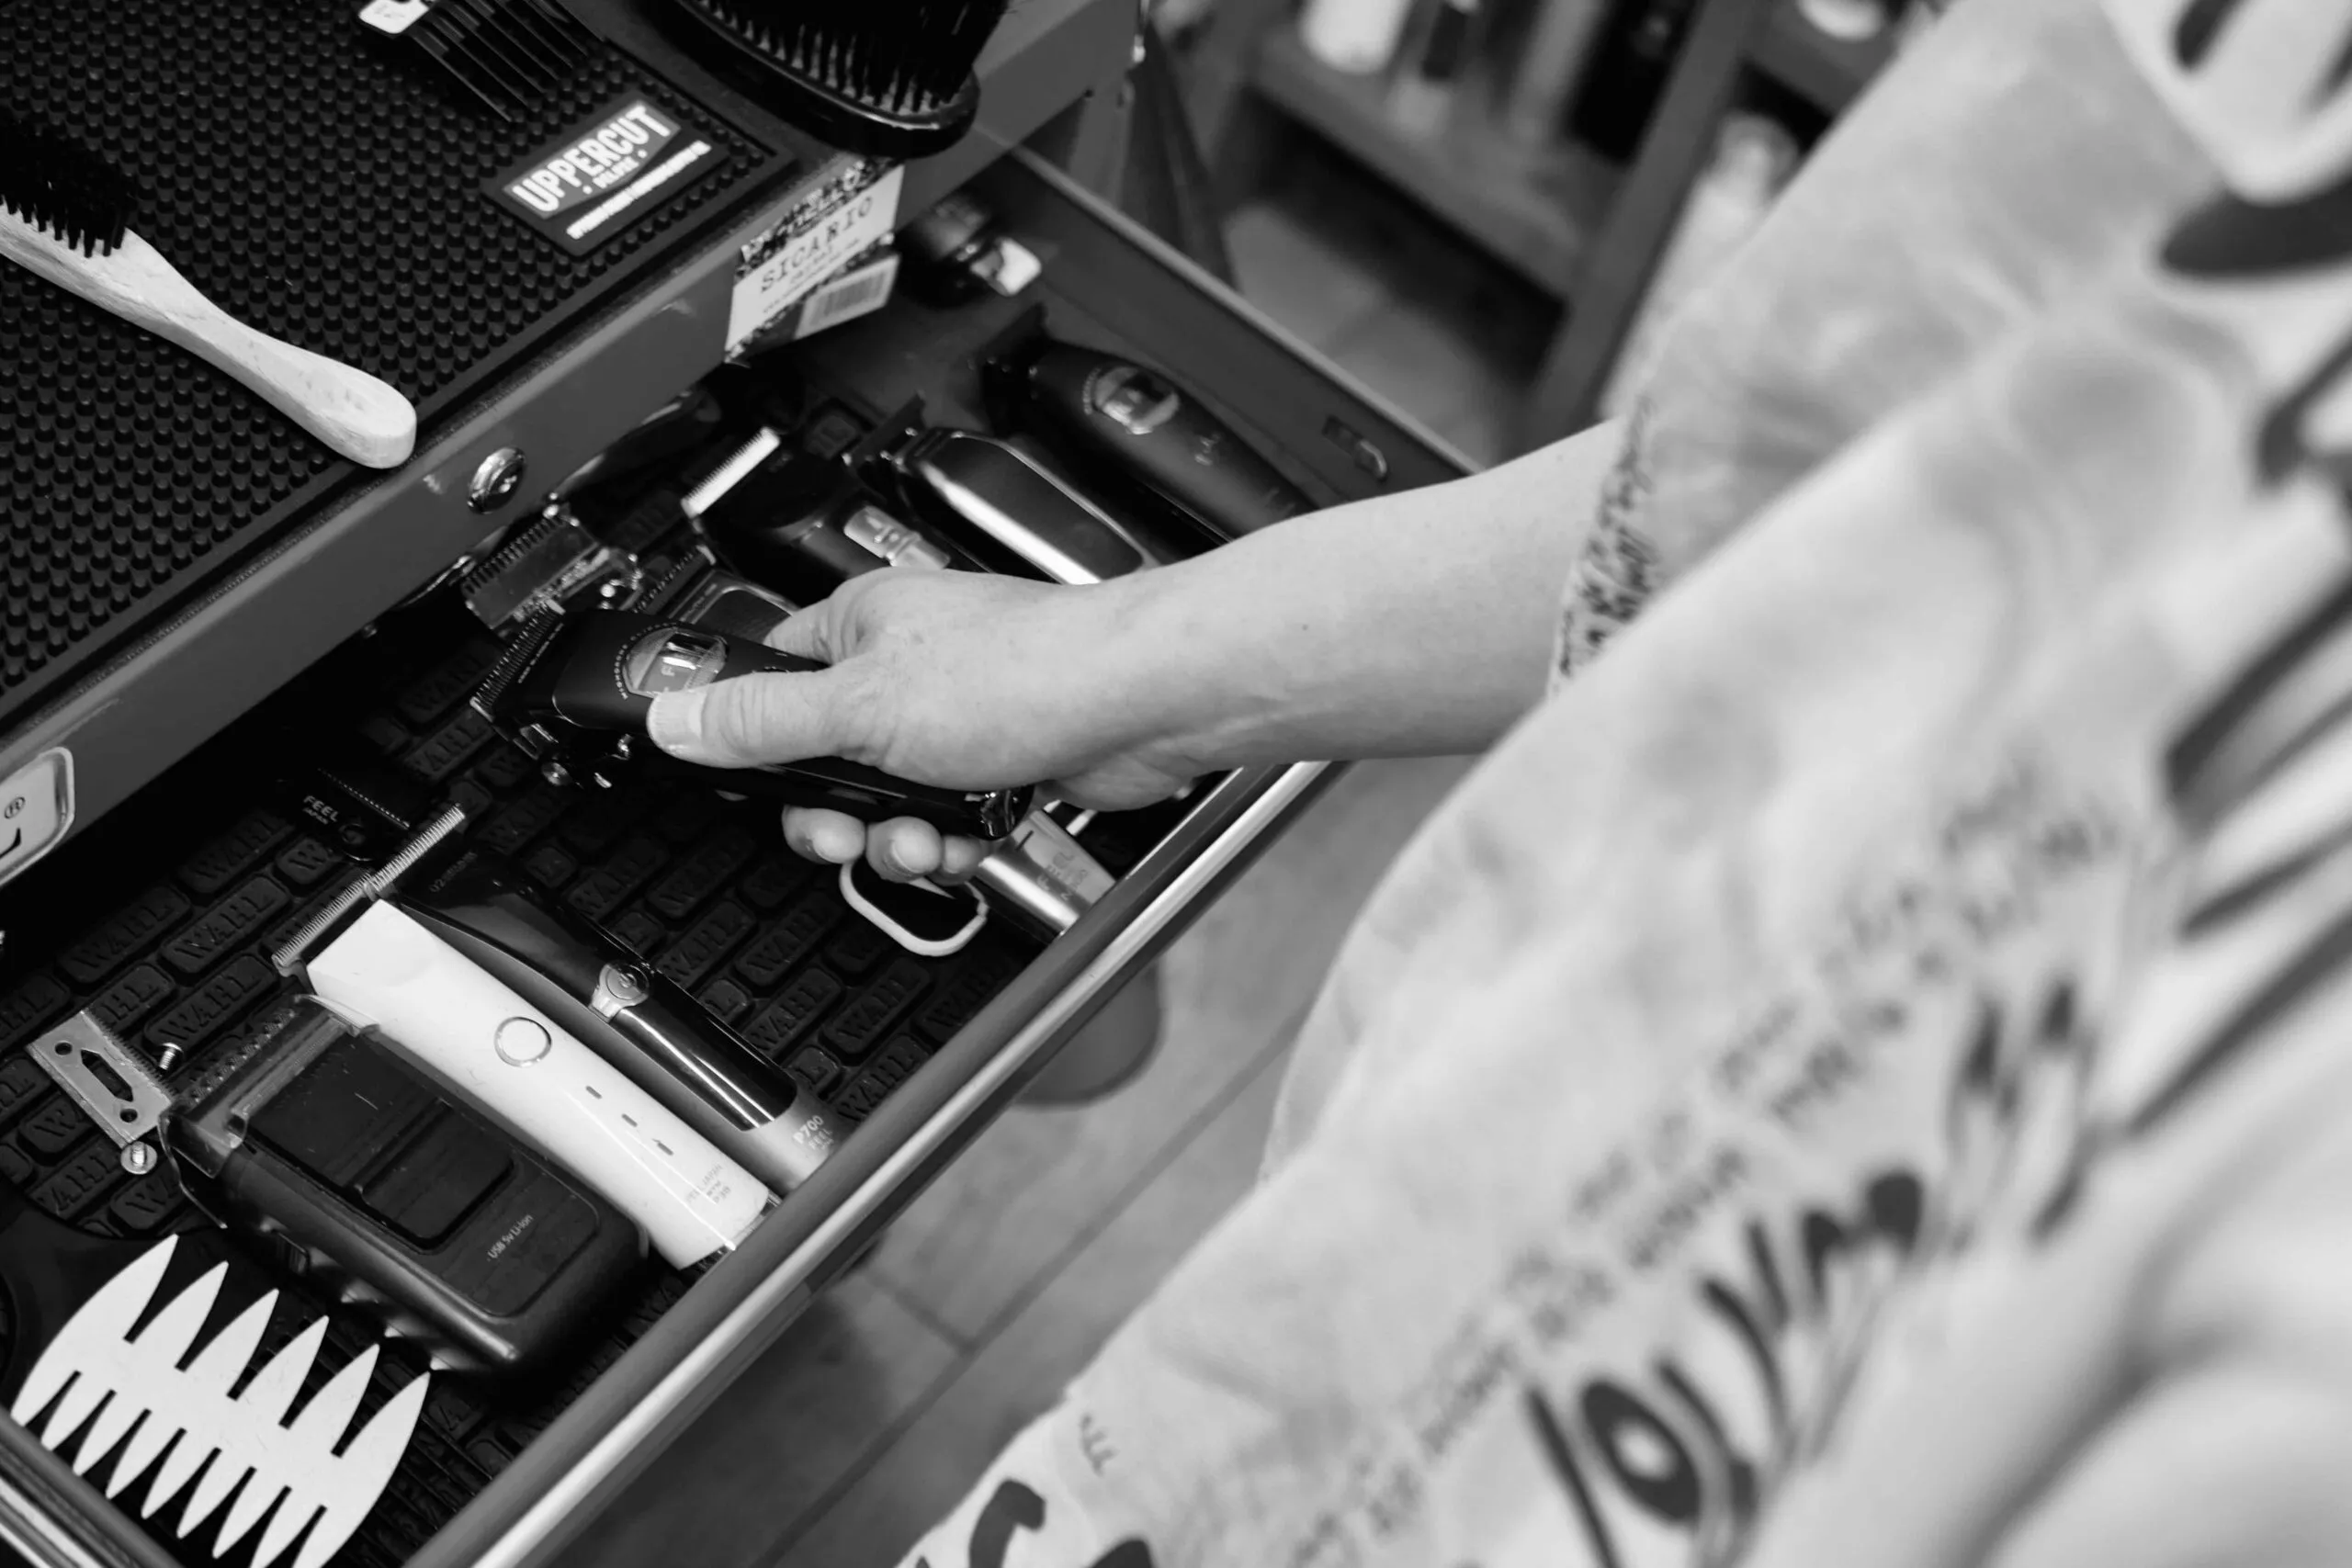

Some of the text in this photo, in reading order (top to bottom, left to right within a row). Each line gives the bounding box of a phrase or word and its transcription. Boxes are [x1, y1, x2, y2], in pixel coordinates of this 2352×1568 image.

[512, 105, 671, 212] UPPERCUT
[761, 196, 872, 293] SICARIO
[303, 795, 340, 822] FEEL
[71, 904, 175, 968] WAHL
[175, 896, 276, 958] WAHL
[159, 976, 263, 1040] WAHL
[749, 986, 831, 1051] WAHL
[837, 1055, 916, 1122] WAHL
[792, 1114, 825, 1145] P700
[487, 1240, 506, 1258] USB
